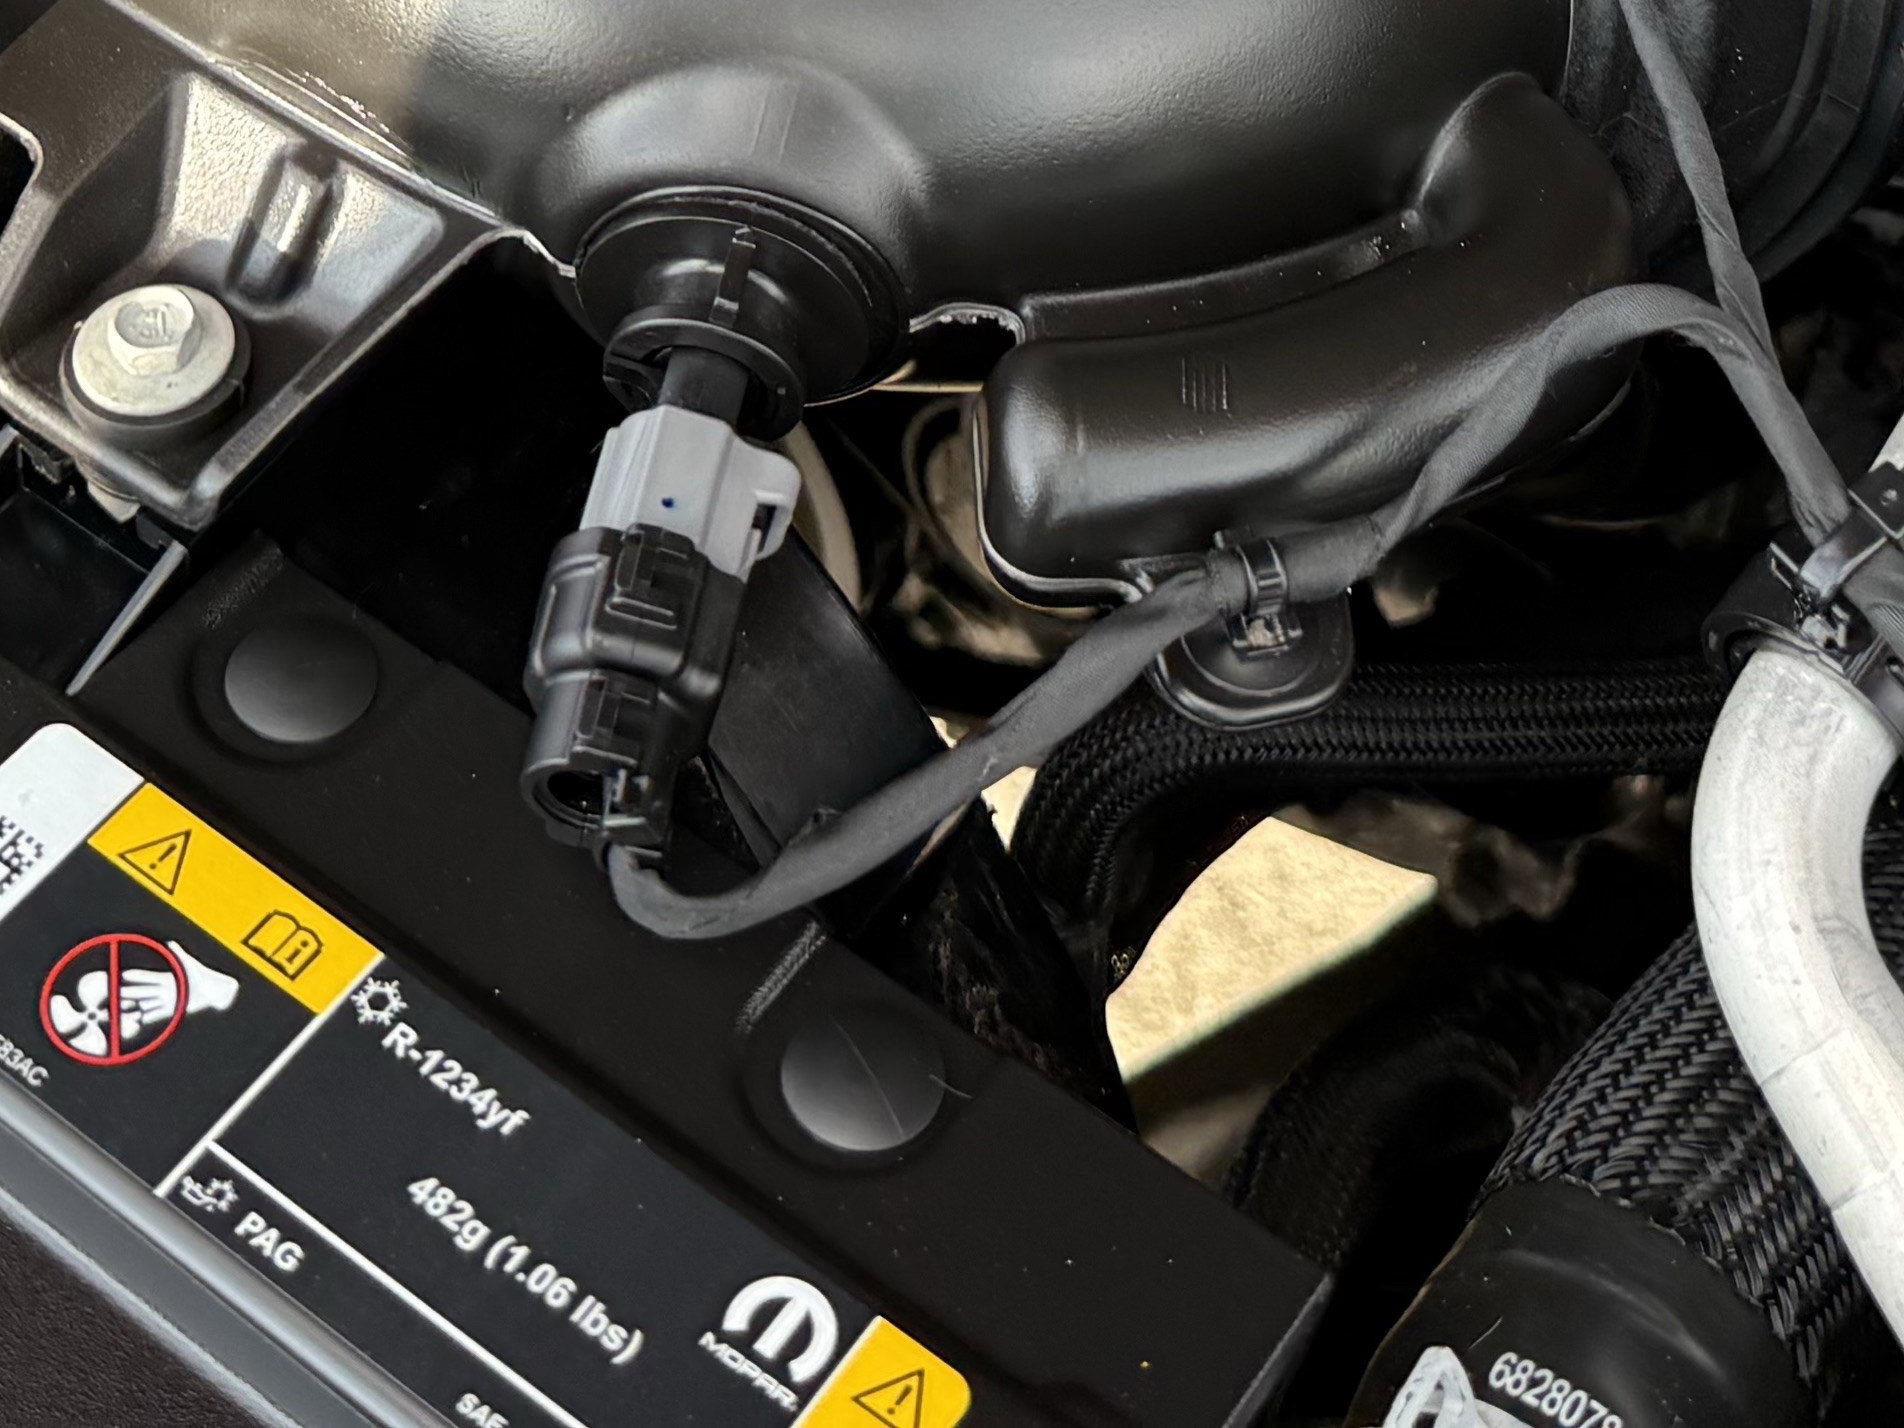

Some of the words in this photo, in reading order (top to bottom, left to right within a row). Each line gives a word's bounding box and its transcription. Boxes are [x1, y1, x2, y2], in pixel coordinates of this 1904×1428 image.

[381, 1021, 531, 1136] R-1234yf
[233, 1210, 306, 1273] PAG
[406, 1176, 492, 1252] 482g
[483, 1234, 578, 1309] (1.06
[568, 1294, 646, 1366] lbs)
